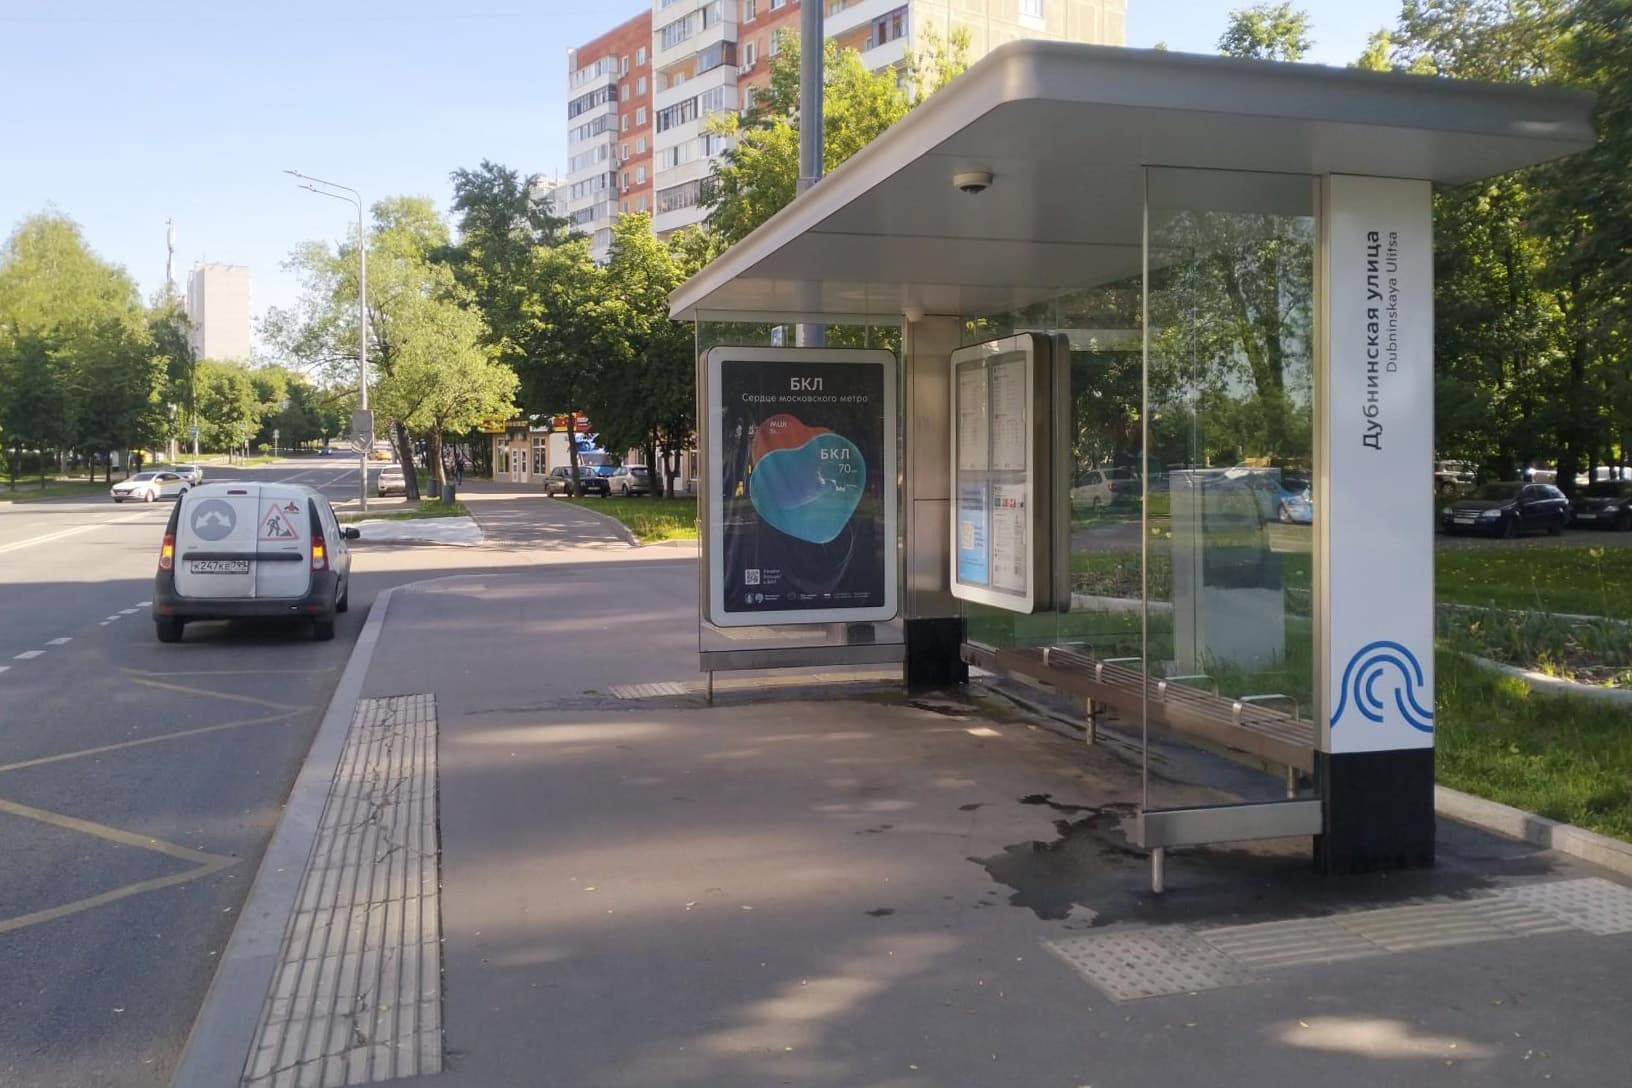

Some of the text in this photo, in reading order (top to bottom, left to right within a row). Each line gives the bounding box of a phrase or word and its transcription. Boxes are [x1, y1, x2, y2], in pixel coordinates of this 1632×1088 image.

[1386, 231, 1400, 373] Dubninskaya Ulitsa
[1363, 231, 1383, 450] Дубнинская улица
[790, 377, 823, 391] БКЛ
[742, 393, 868, 403] Сердце московского метро
[820, 448, 850, 460] БКЛ
[838, 463, 851, 473] 70
